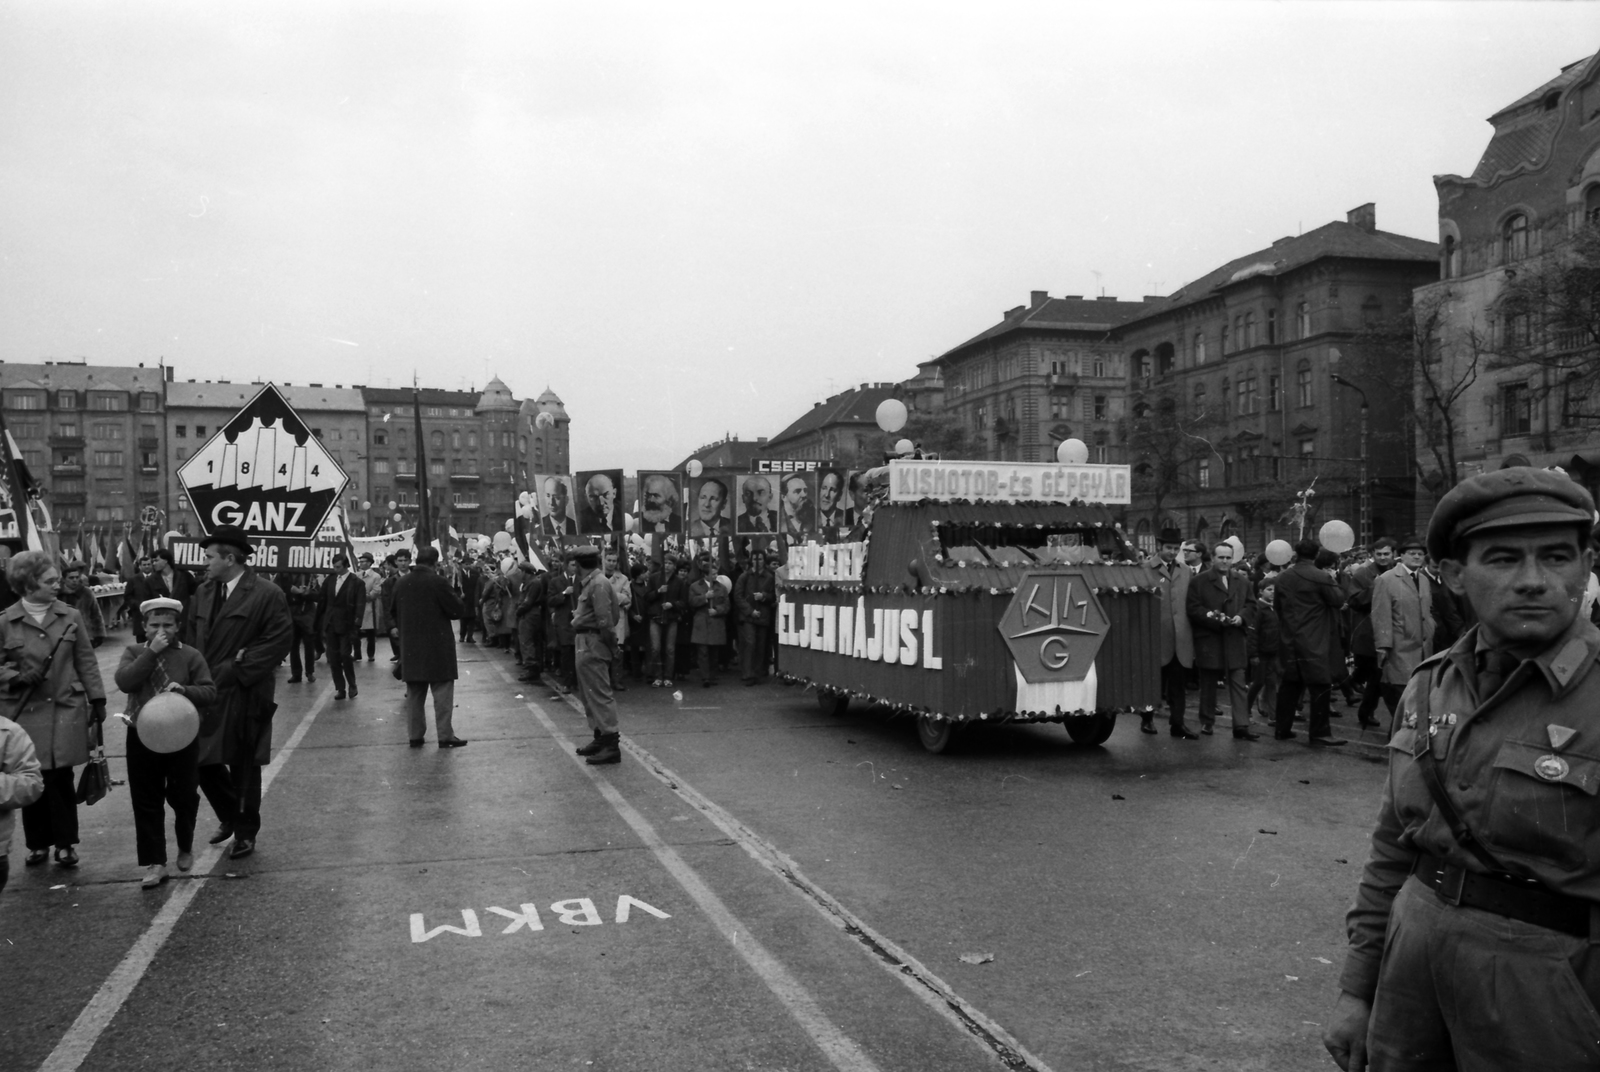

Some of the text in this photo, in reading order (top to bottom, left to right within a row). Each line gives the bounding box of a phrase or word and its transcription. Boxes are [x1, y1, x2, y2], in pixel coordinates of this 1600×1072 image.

[1041, 466, 1126, 498] GÉPGYÁR
[211, 500, 307, 532] GANZ
[778, 594, 836, 653] ÉLJEN
[839, 595, 918, 666] MÁJUS
[409, 894, 673, 943] VBKM
